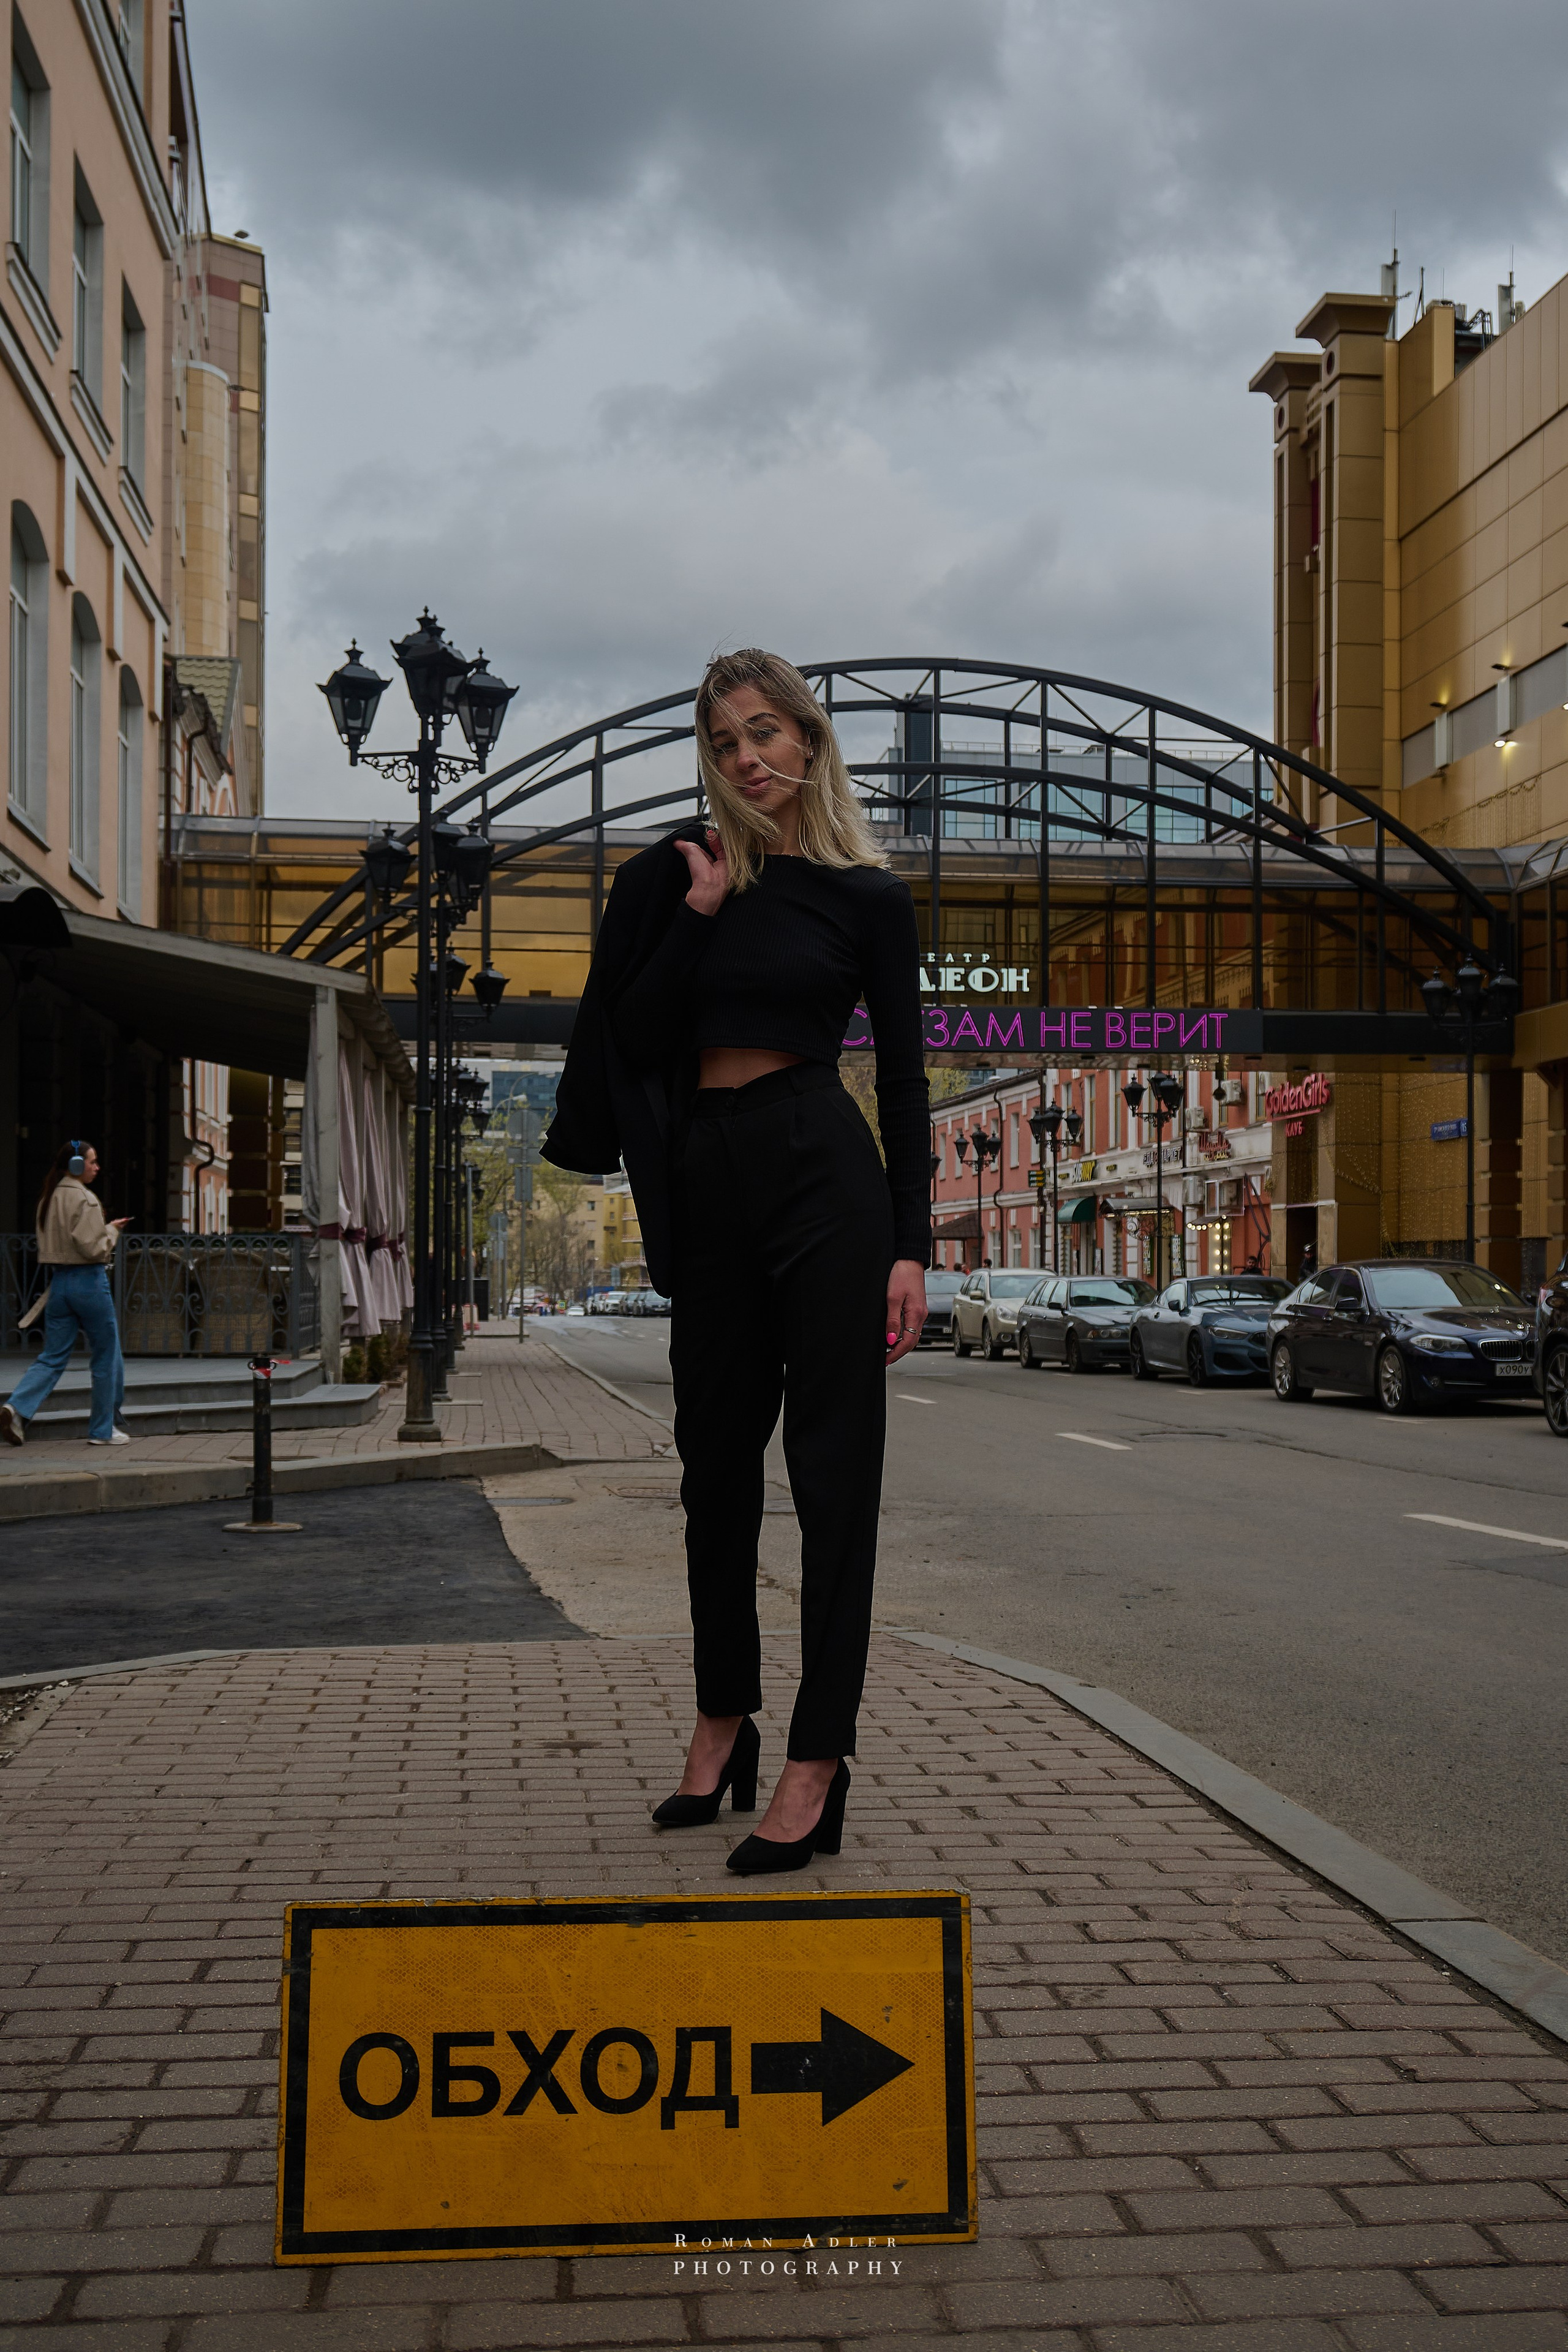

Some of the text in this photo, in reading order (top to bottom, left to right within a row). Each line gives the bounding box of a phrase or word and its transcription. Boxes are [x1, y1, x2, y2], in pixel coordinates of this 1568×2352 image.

[927, 952, 990, 963] ЕАТР
[843, 1008, 1229, 1049] СЗАМ НЕ ВЕРИТ
[1285, 1121, 1303, 1137] КЛУБ
[1161, 1146, 1181, 1163] АРКЕТ
[1072, 1160, 1096, 1183] SUBWAY
[1499, 1365, 1532, 1374] Х090У
[338, 2025, 740, 2132] ОБХОД
